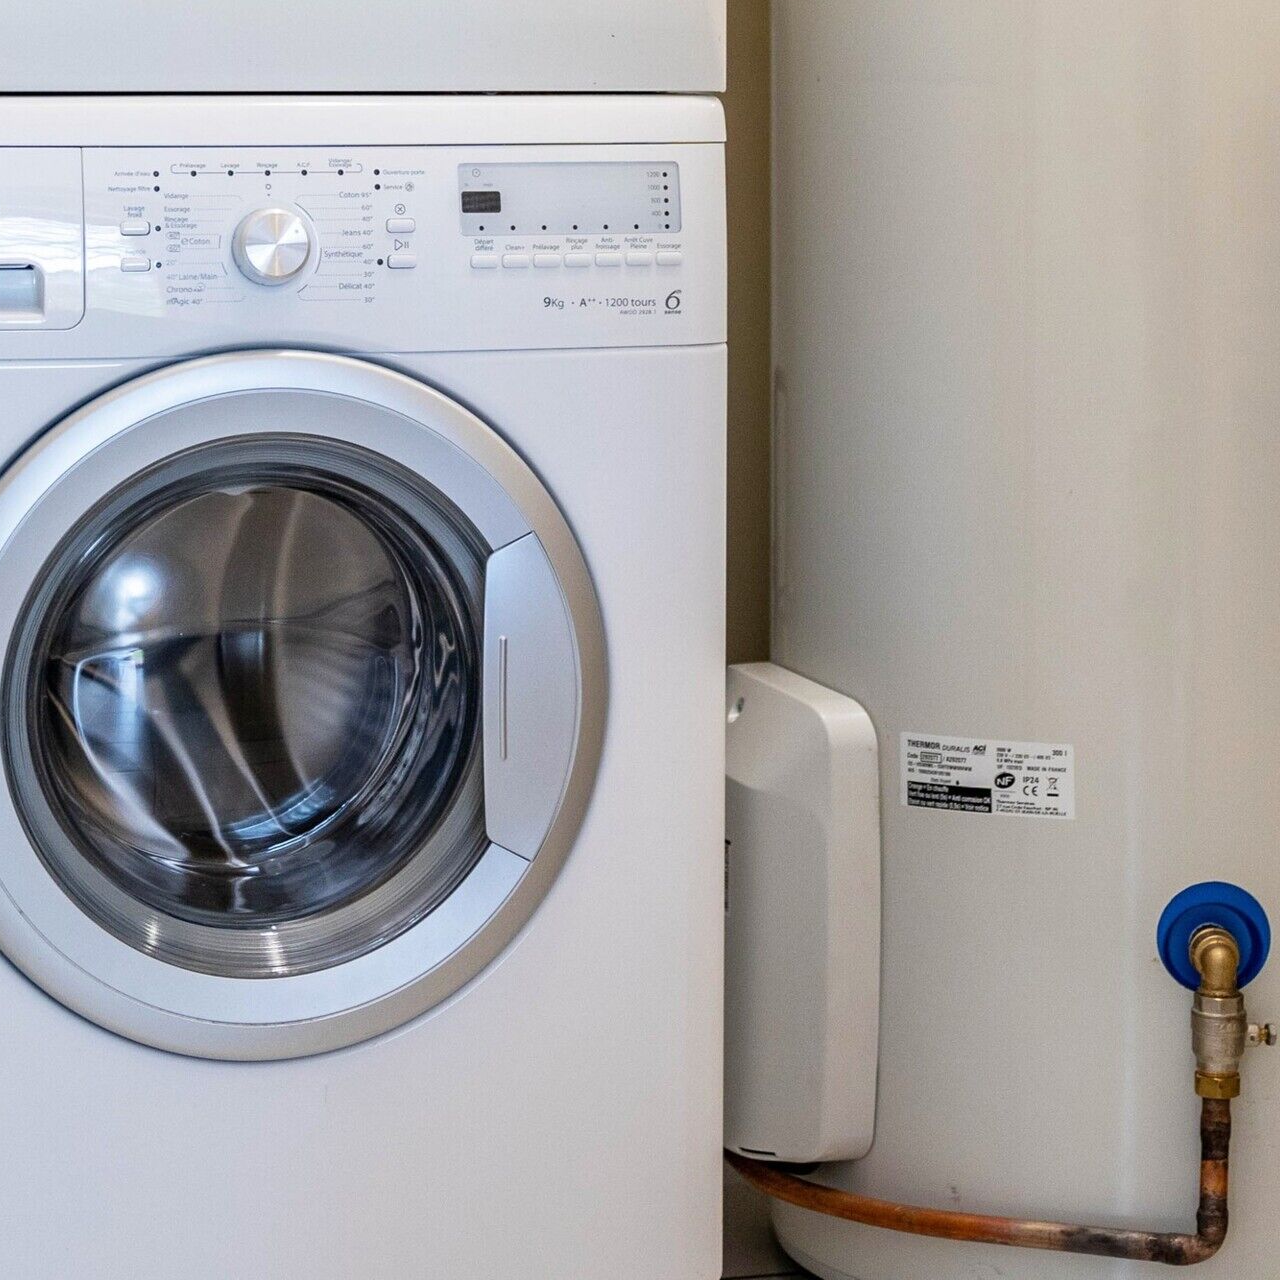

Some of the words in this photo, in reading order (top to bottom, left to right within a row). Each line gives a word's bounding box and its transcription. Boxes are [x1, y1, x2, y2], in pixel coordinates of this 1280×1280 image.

[324, 250, 364, 258] Synthétique
[338, 282, 362, 290] Délicat
[543, 297, 565, 310] 9Kg
[579, 298, 596, 307] A++
[605, 298, 629, 307] 1200
[631, 298, 657, 307] tours
[907, 739, 941, 750] THERMOR
[942, 744, 971, 753] DURALIS
[973, 744, 987, 752] ACI
[996, 776, 1014, 786] NF
[1022, 776, 1039, 784] IP24
